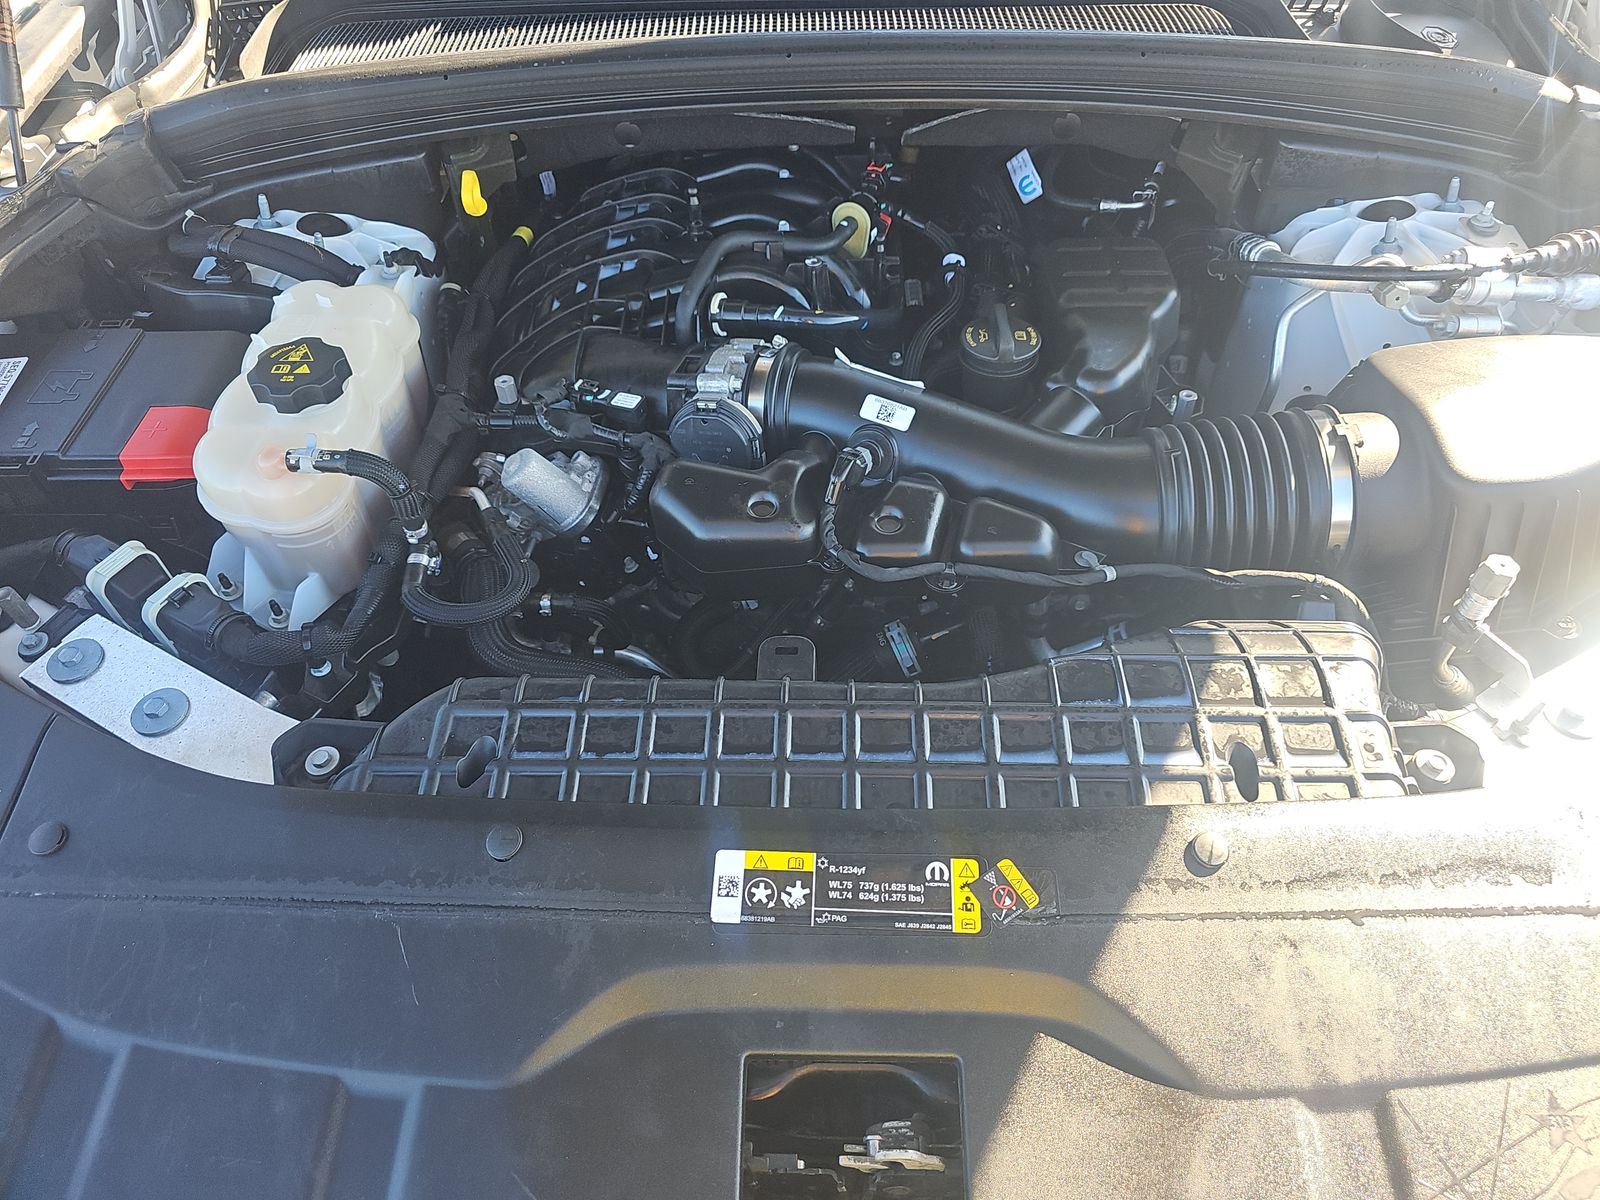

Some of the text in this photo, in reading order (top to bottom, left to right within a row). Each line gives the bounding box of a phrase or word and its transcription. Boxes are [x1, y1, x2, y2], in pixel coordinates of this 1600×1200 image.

[829, 865, 866, 875] R-1234yf
[828, 880, 925, 894] WL75 737g (1.625 lbs)
[828, 890, 925, 904] WL74 624g (1.375 lbs)
[831, 914, 848, 922] PAG
